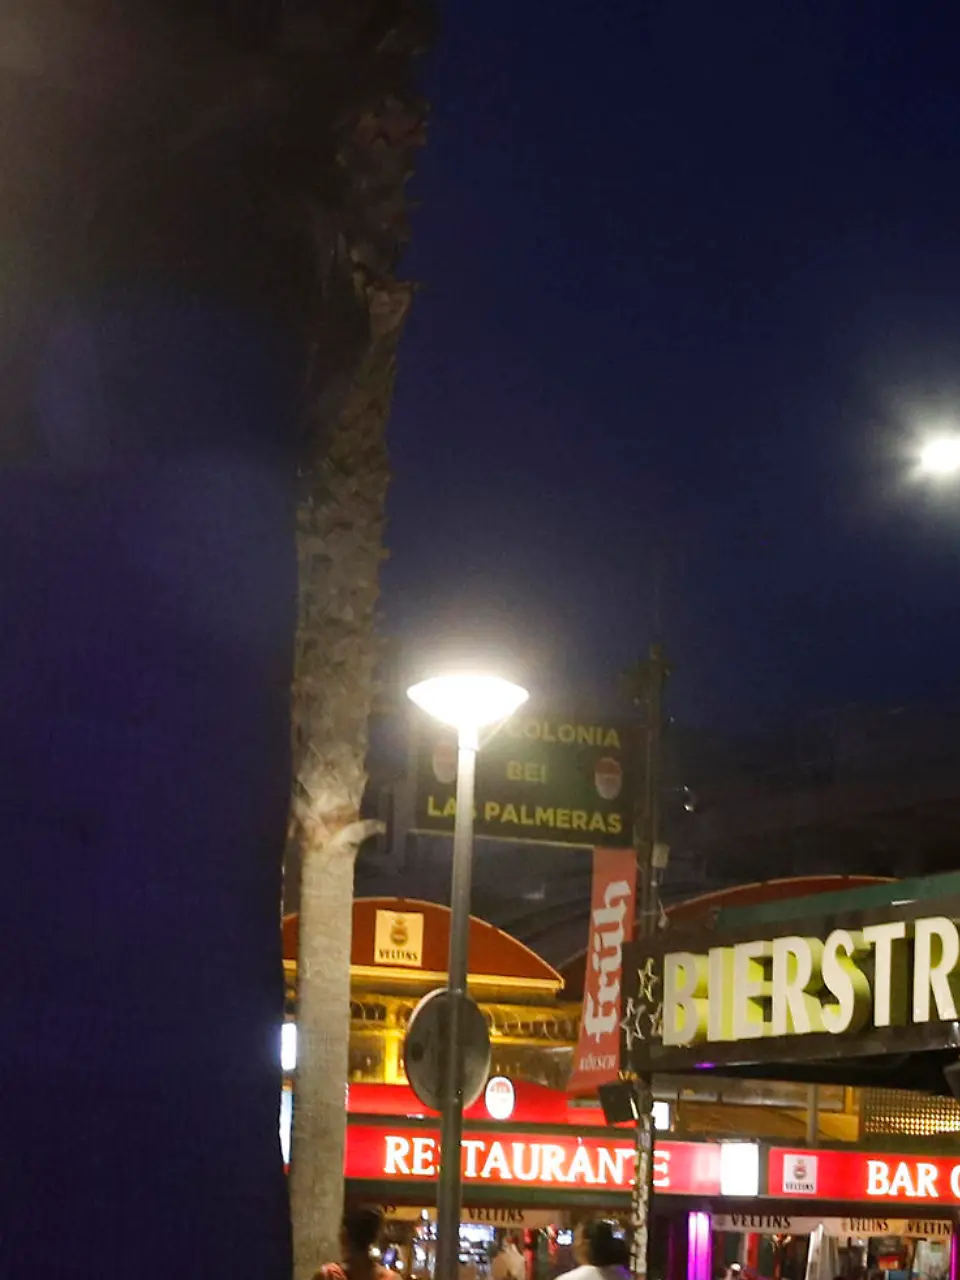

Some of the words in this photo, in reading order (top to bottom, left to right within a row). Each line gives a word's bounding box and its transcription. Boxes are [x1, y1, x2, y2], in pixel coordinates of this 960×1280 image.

[507, 760, 546, 784] BEI
[485, 801, 622, 834] PALMERAS
[384, 1136, 671, 1187] RETAURANE
[867, 1160, 939, 1198] BAR
[468, 1206, 525, 1222] VELTINS
[730, 1212, 791, 1229] VELTINS
[907, 1221, 951, 1235] VELTIN
